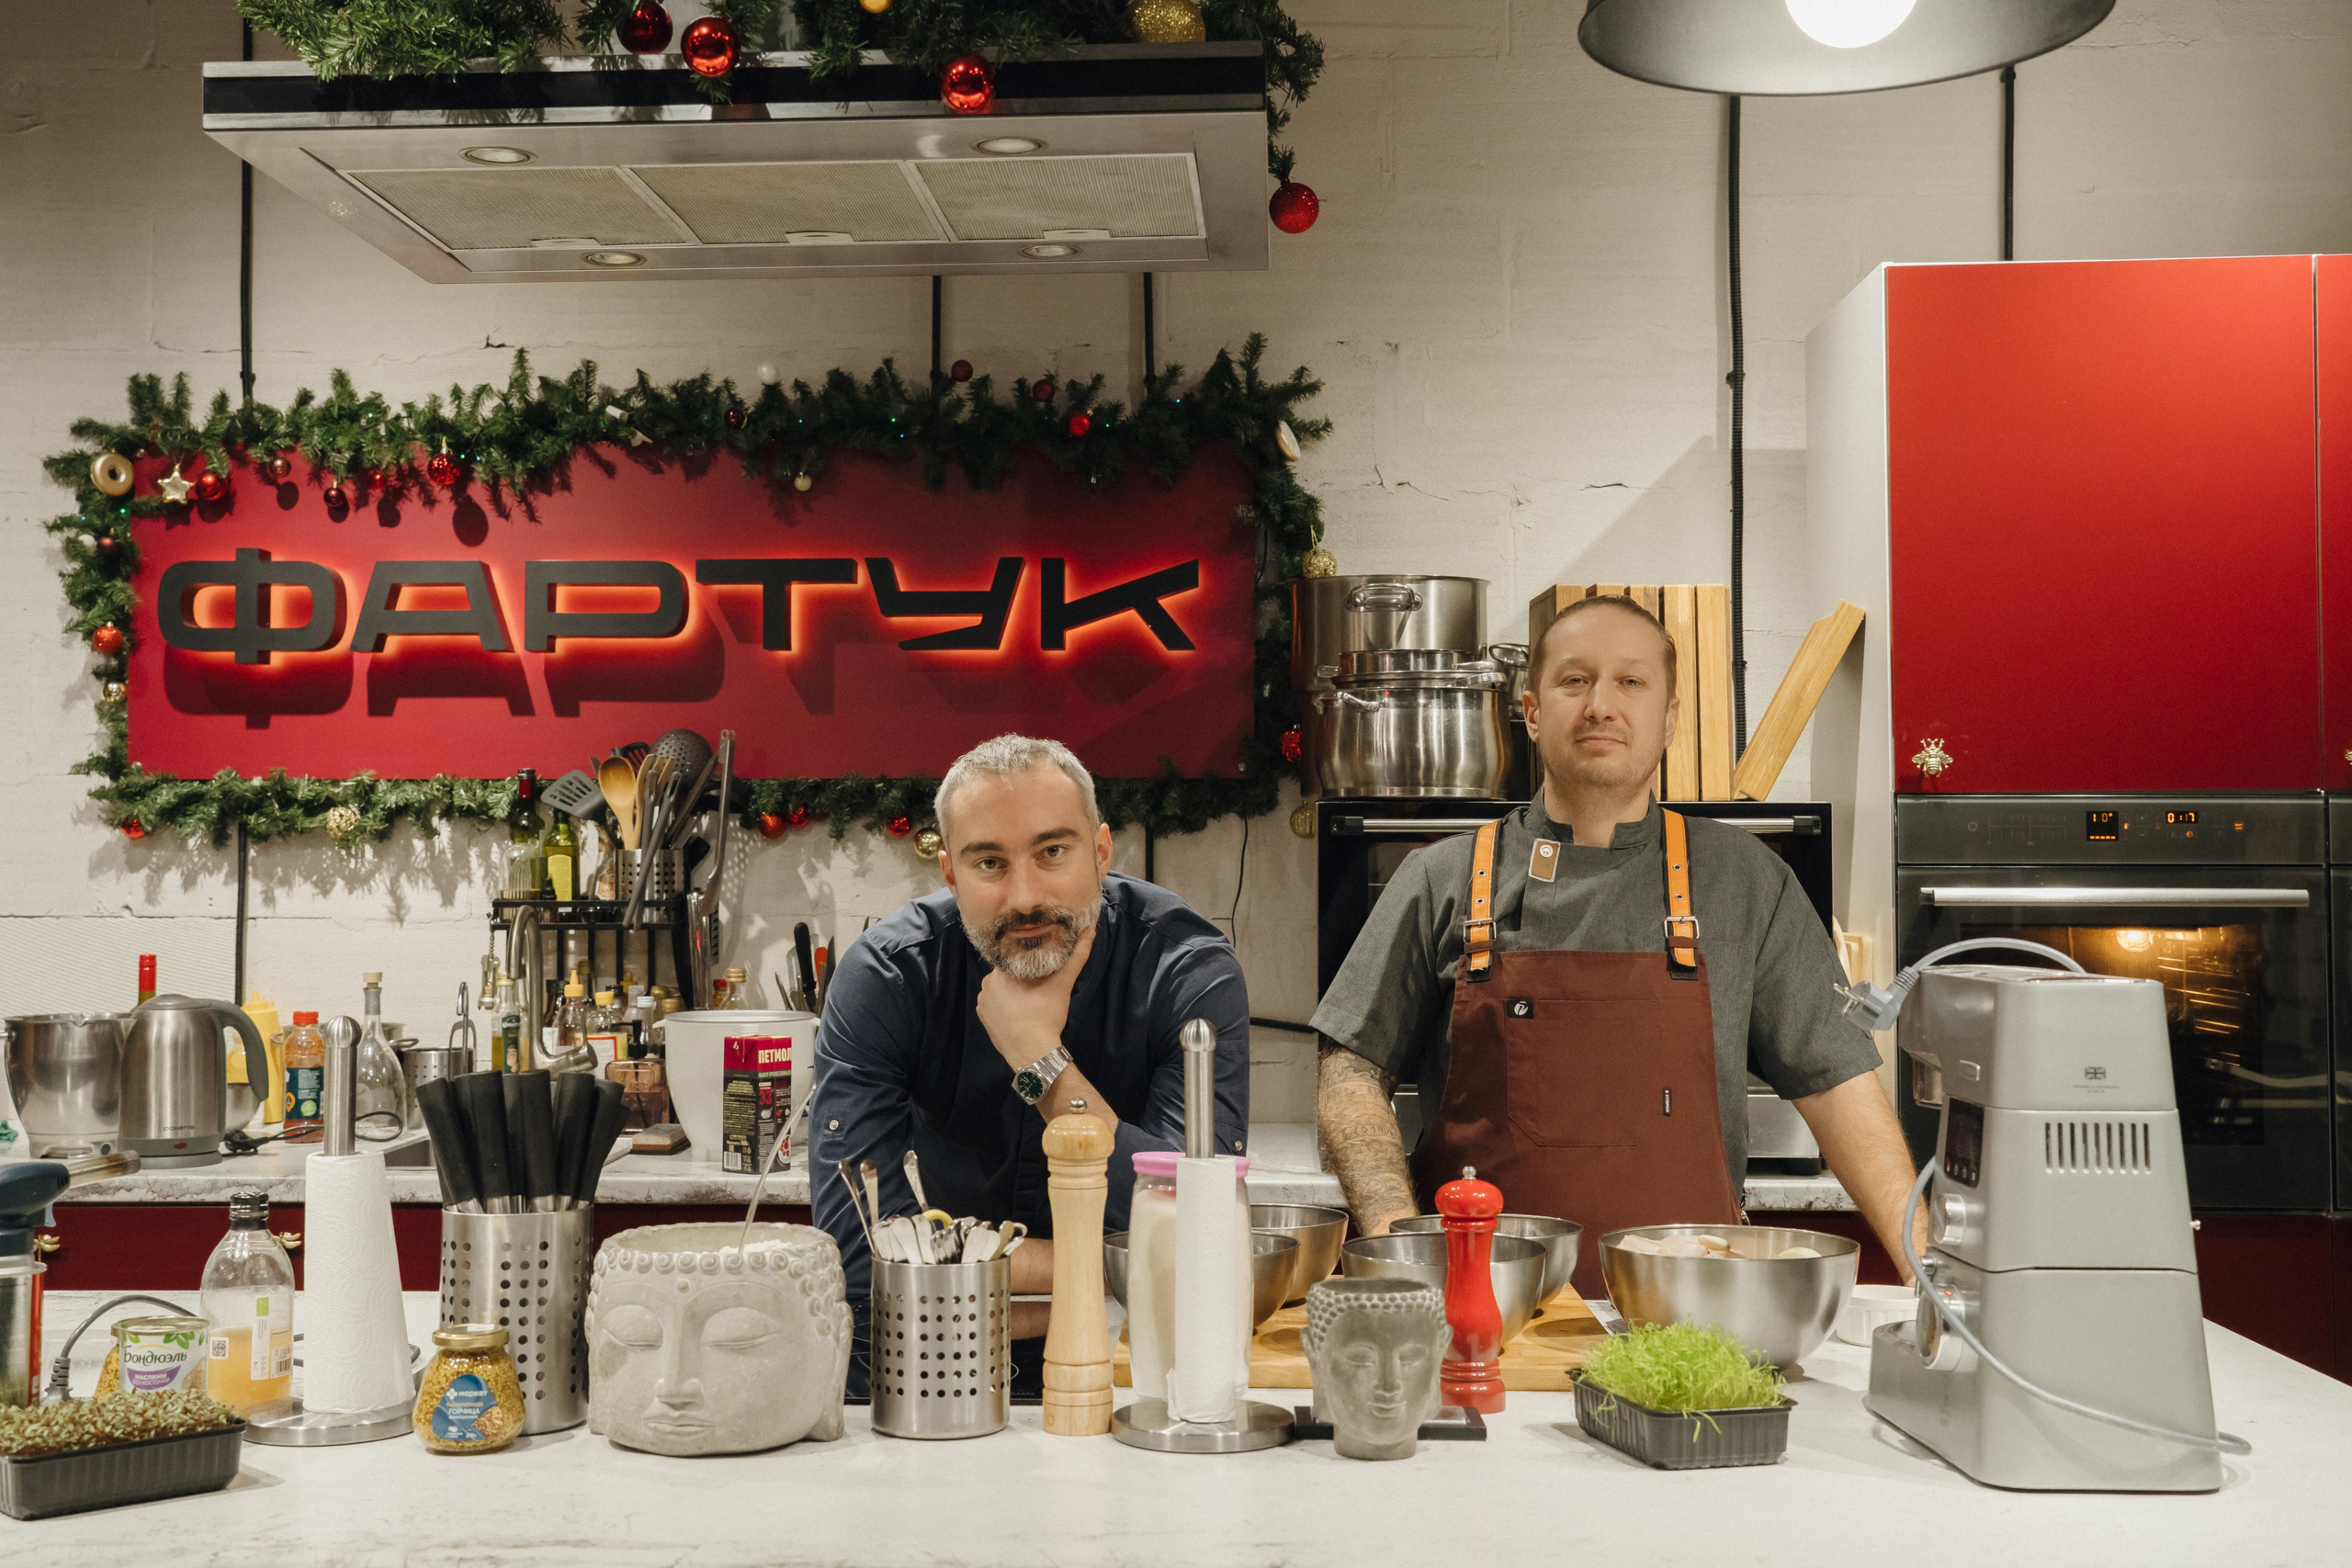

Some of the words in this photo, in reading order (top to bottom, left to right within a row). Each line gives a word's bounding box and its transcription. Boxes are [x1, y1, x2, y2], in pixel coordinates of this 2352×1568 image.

[157, 547, 1199, 664] ФАРТУК
[123, 1345, 187, 1367] Бондюэль
[134, 1372, 167, 1381] МАСЛИНЫ
